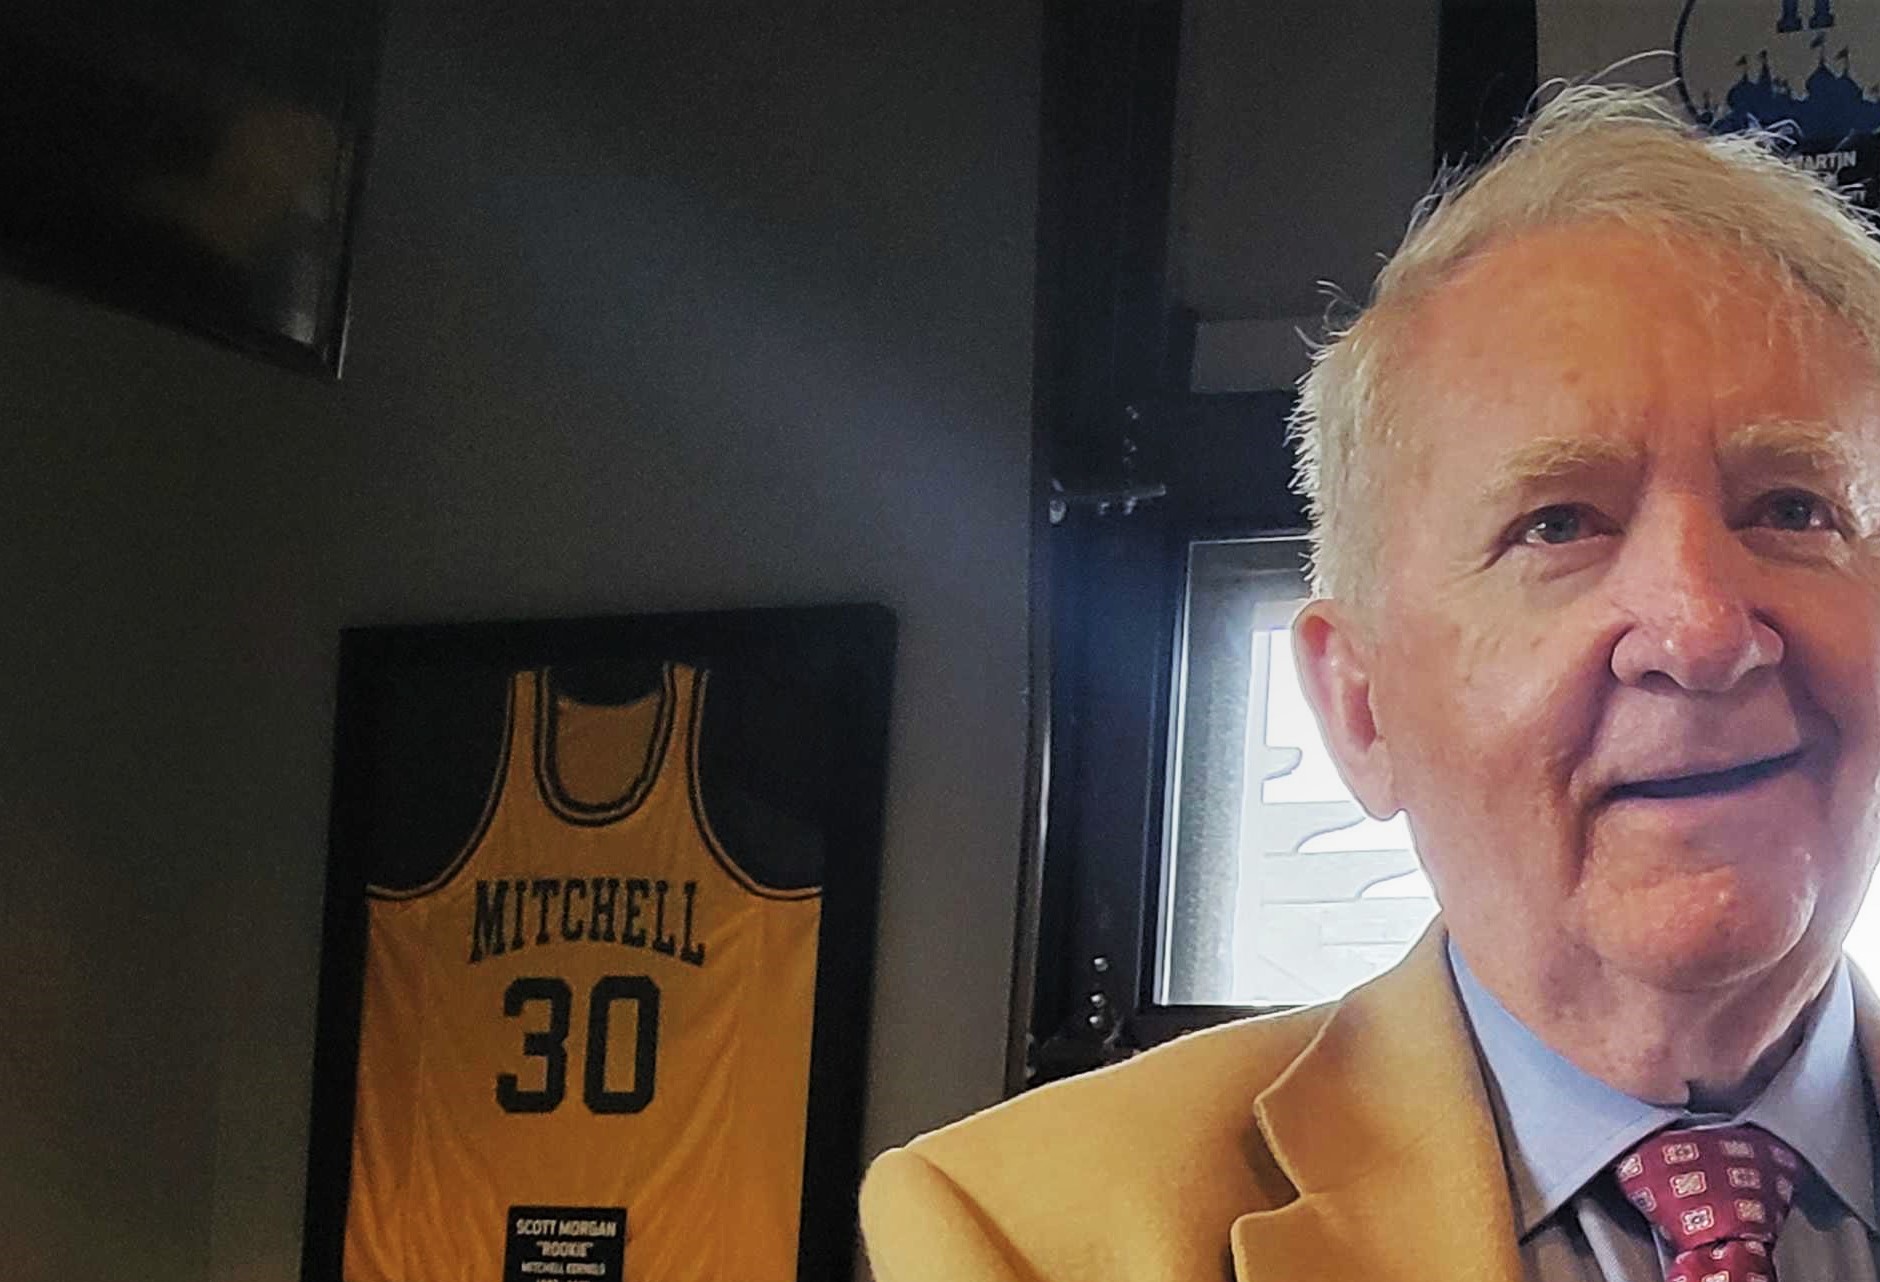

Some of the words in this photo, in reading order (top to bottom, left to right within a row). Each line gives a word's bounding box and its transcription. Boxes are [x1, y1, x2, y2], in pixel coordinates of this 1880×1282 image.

[468, 877, 706, 967] MITCHELL
[496, 974, 661, 1115] 30
[516, 1219, 556, 1235] SCOTT
[559, 1221, 616, 1236] MORGAN
